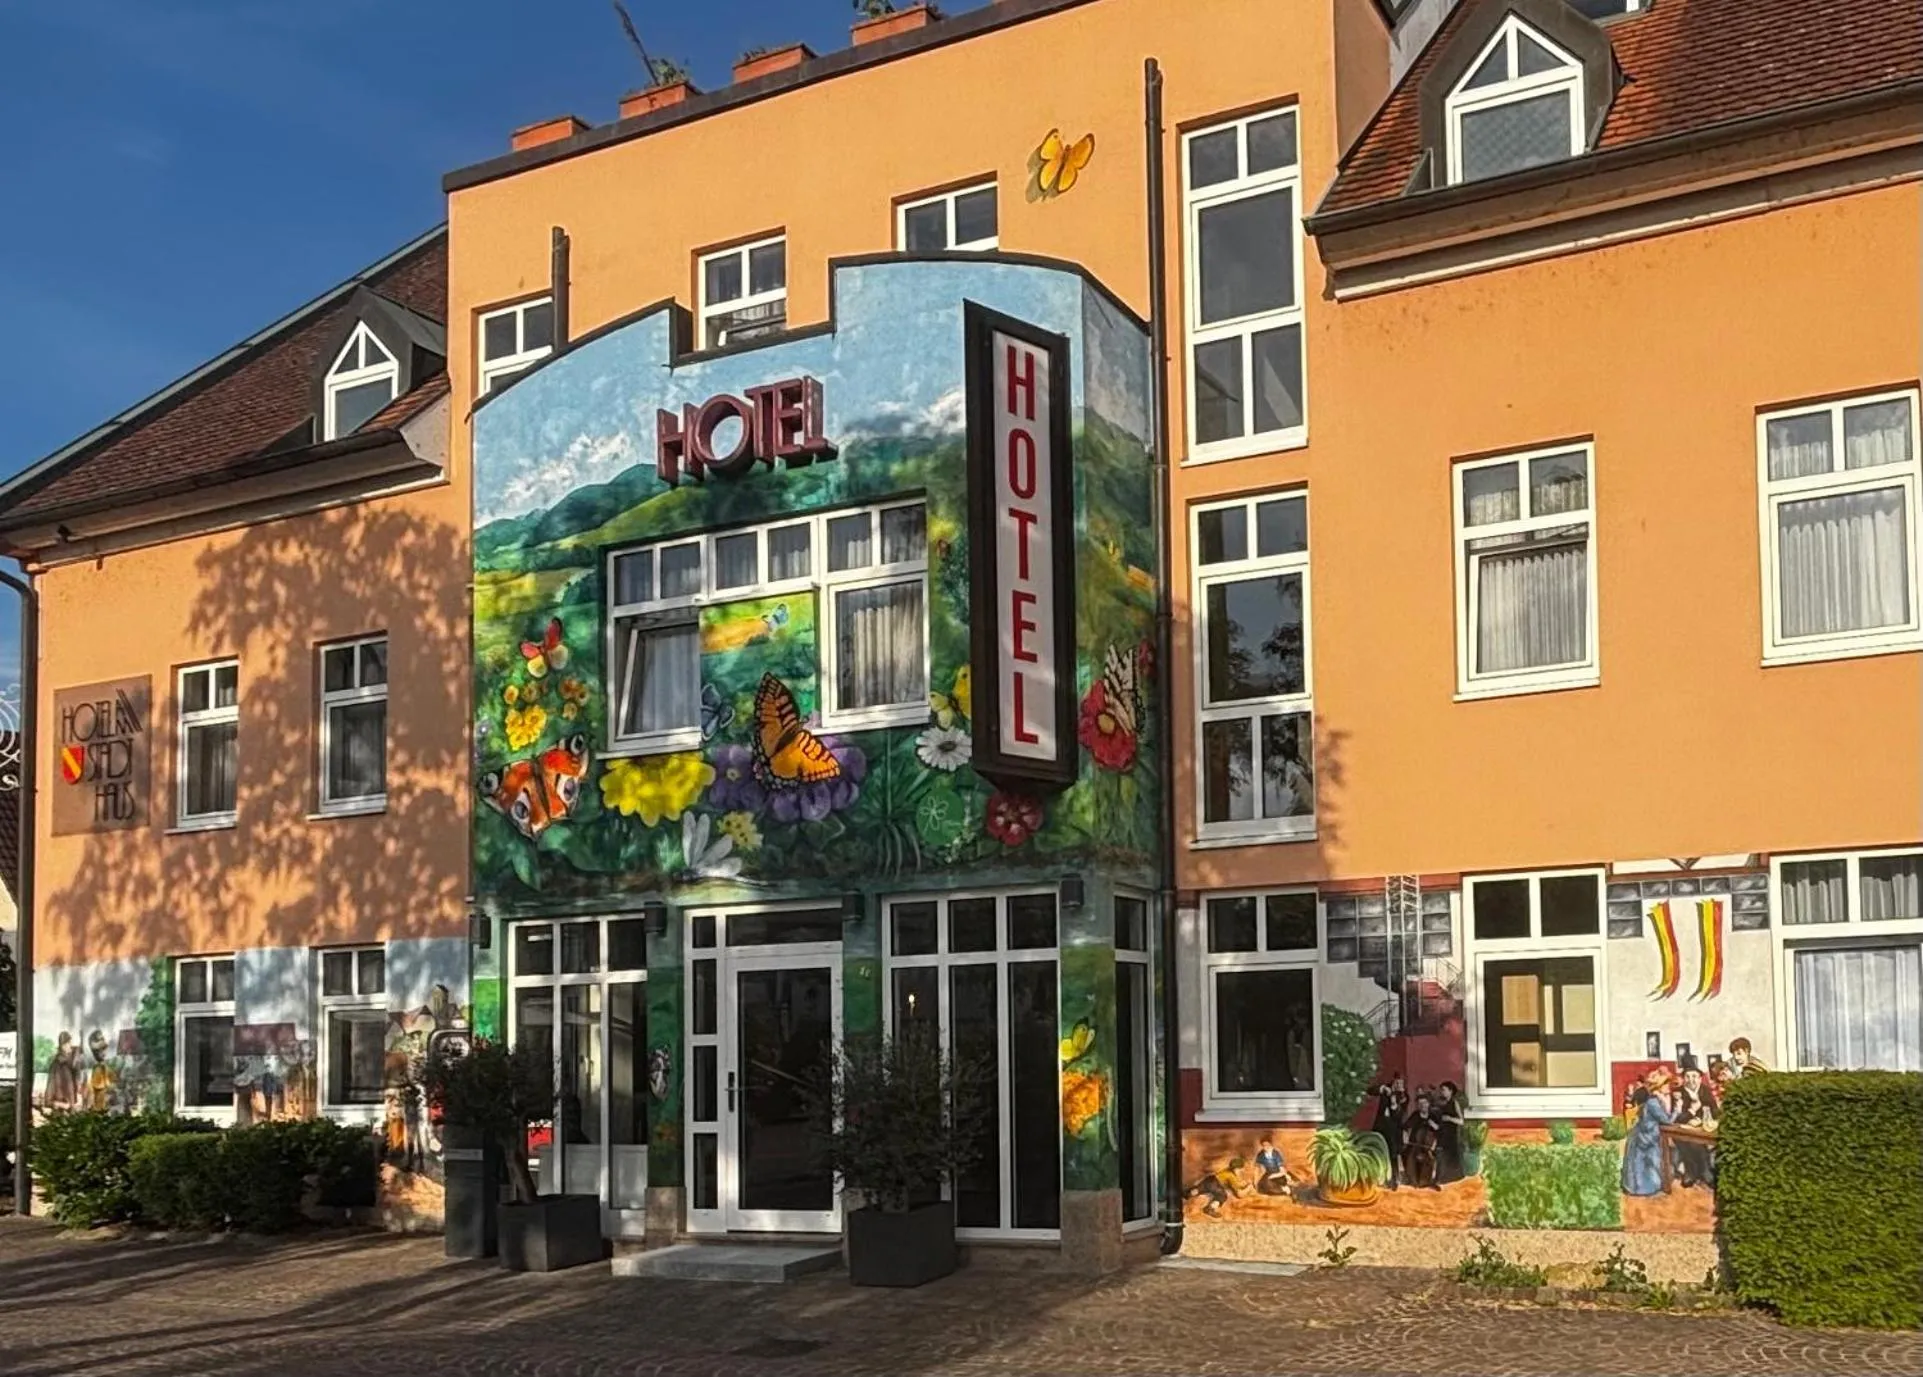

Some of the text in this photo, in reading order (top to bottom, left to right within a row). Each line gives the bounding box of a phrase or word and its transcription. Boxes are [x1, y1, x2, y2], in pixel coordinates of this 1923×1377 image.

[657, 376, 839, 488] HOTEL
[1007, 344, 1039, 745] HOTEL
[62, 701, 114, 743] HOTEL
[94, 781, 136, 821] HAUS
